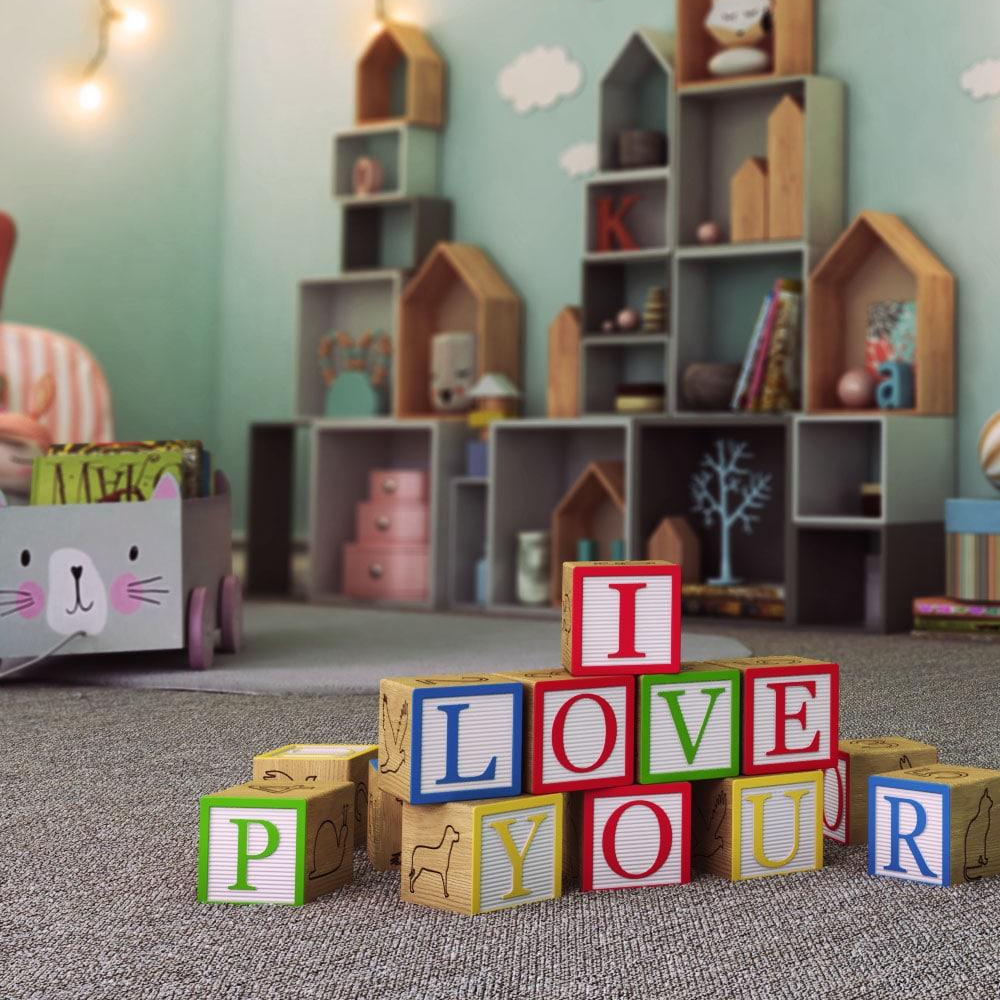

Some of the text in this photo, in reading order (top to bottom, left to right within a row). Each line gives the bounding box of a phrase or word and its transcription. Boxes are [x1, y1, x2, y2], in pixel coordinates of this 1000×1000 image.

[596, 196, 640, 252] K
[607, 583, 647, 659] I
[227, 818, 281, 891] P
